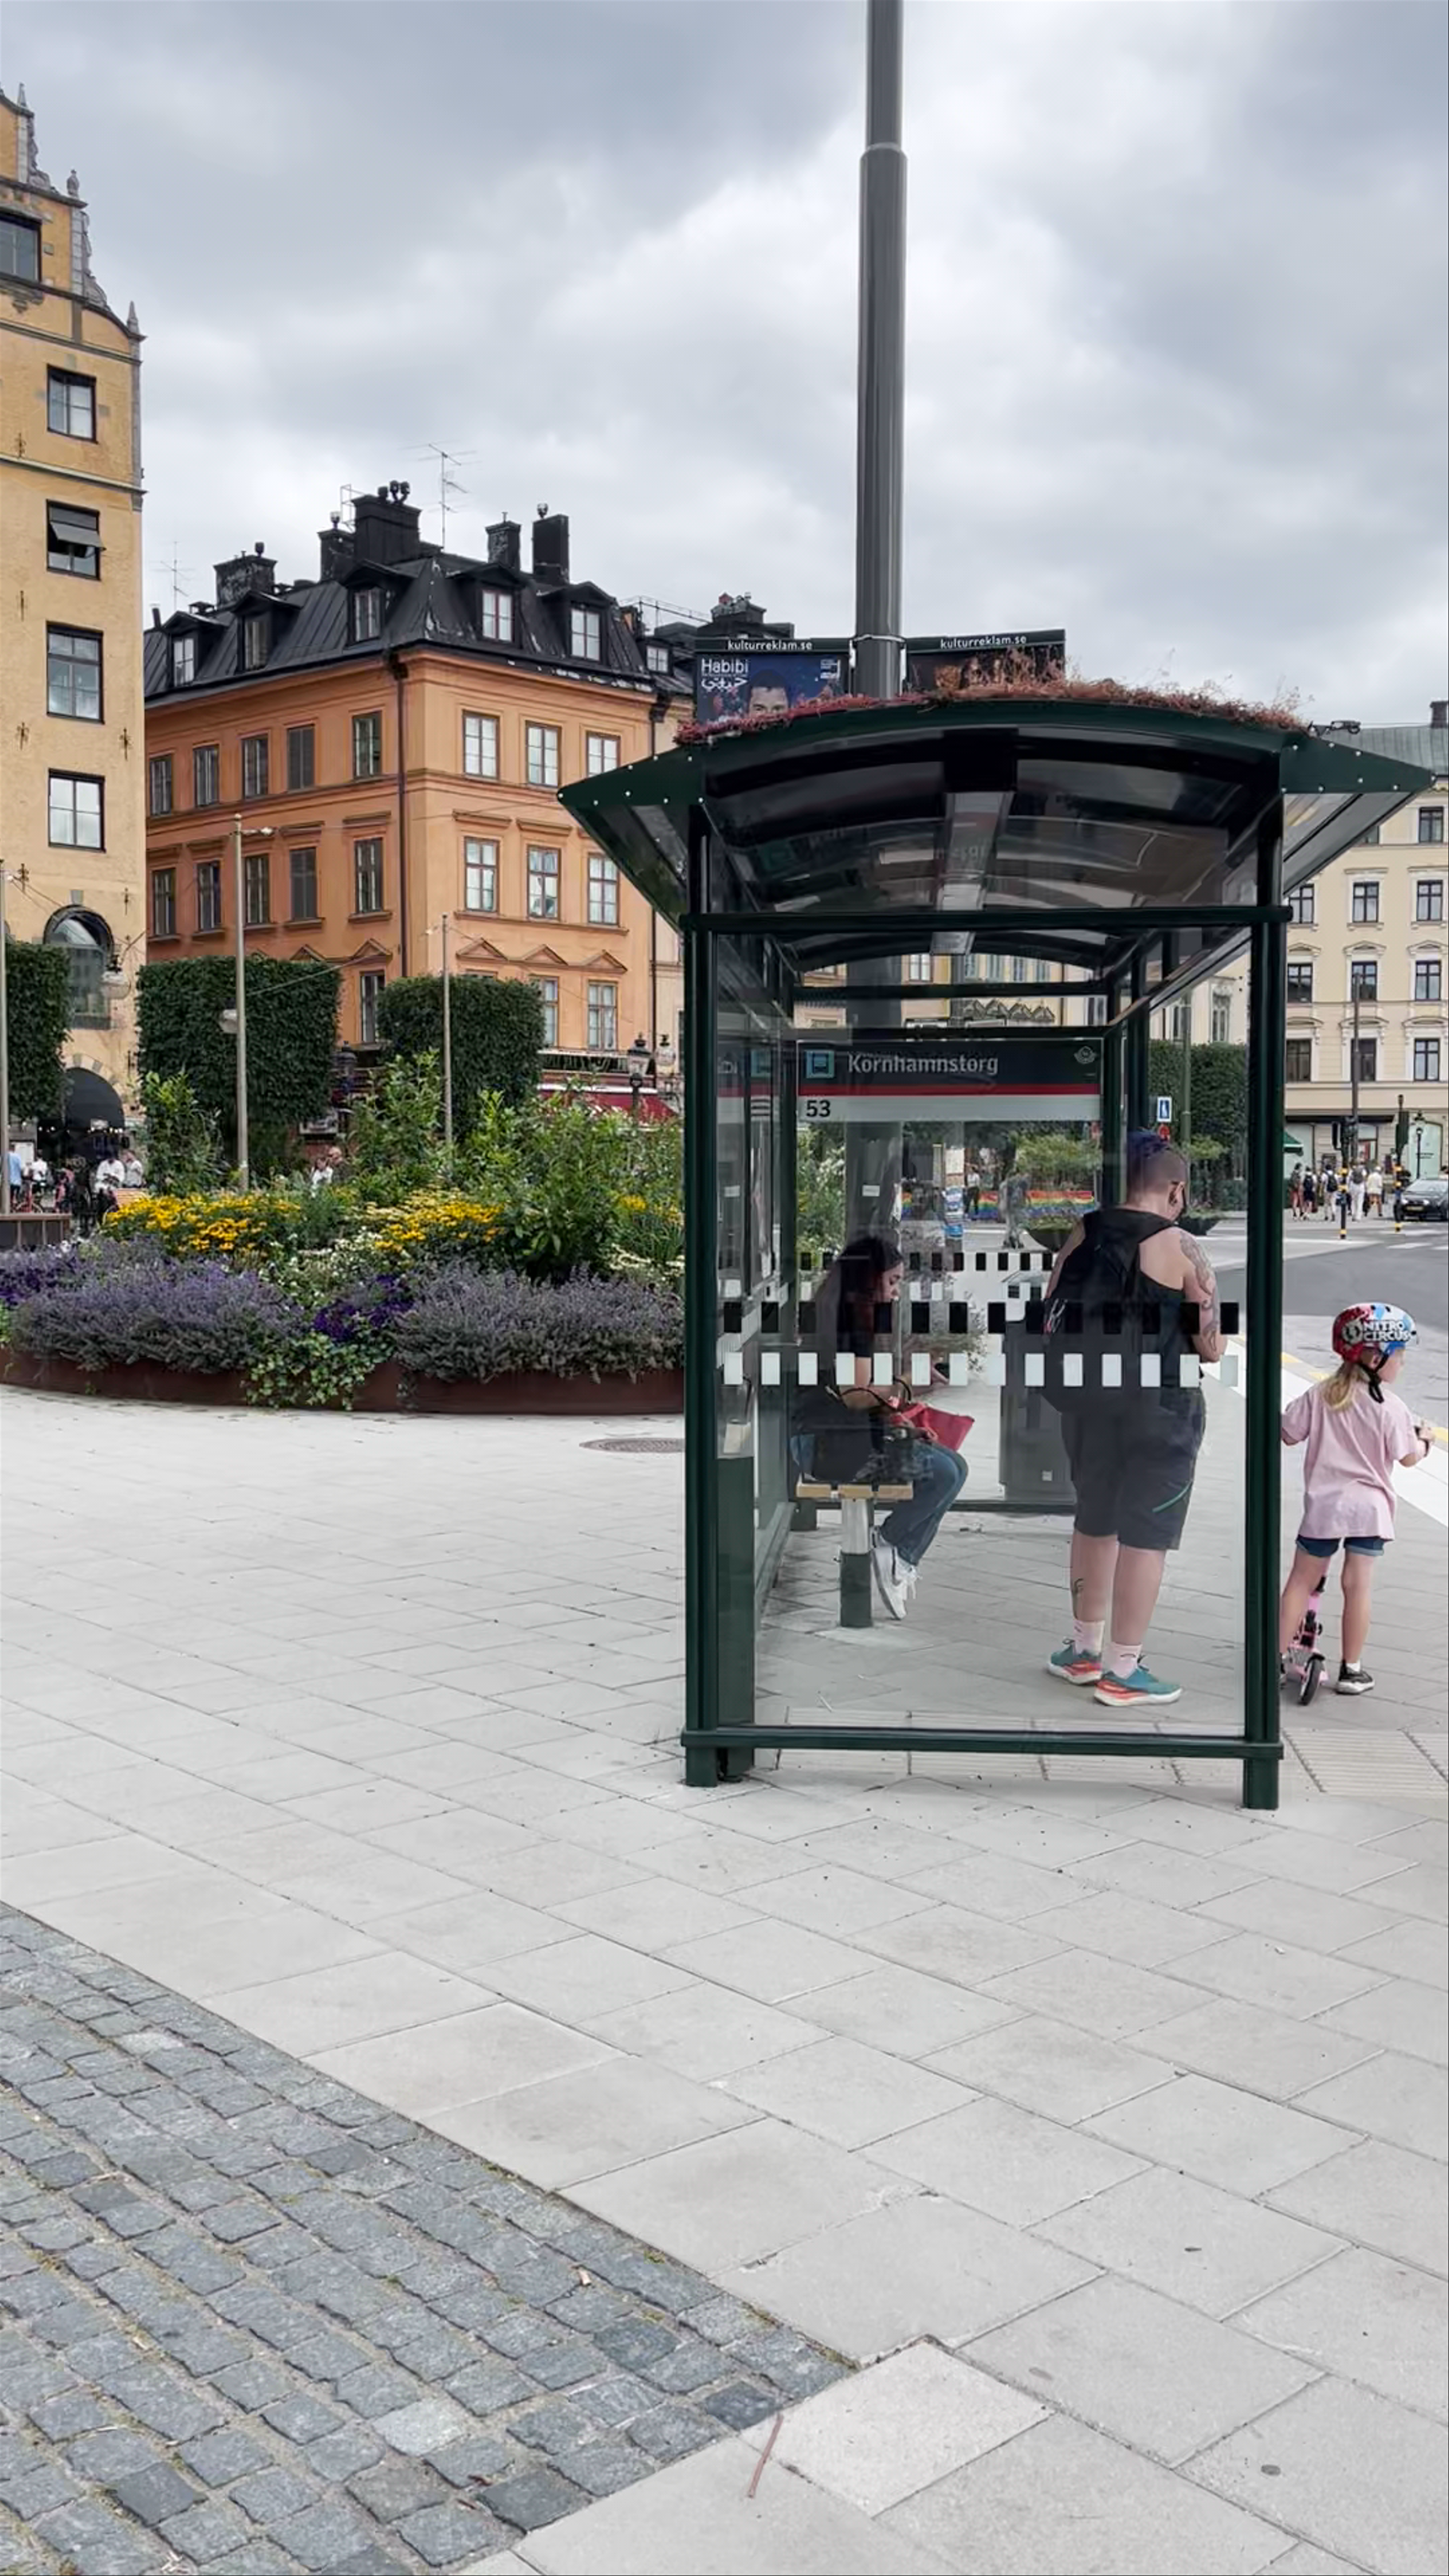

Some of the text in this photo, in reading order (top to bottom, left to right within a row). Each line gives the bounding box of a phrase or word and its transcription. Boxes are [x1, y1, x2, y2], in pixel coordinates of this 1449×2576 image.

[727, 640, 812, 651] kulturreklam.se
[940, 635, 1027, 649] kulturreklam.se
[701, 658, 749, 673] Habibi
[848, 1053, 999, 1075] Kornhamnstorg
[806, 1100, 831, 1117] 53
[1364, 1321, 1404, 1331] NITRO
[1363, 1330, 1412, 1341] CIRCUS
